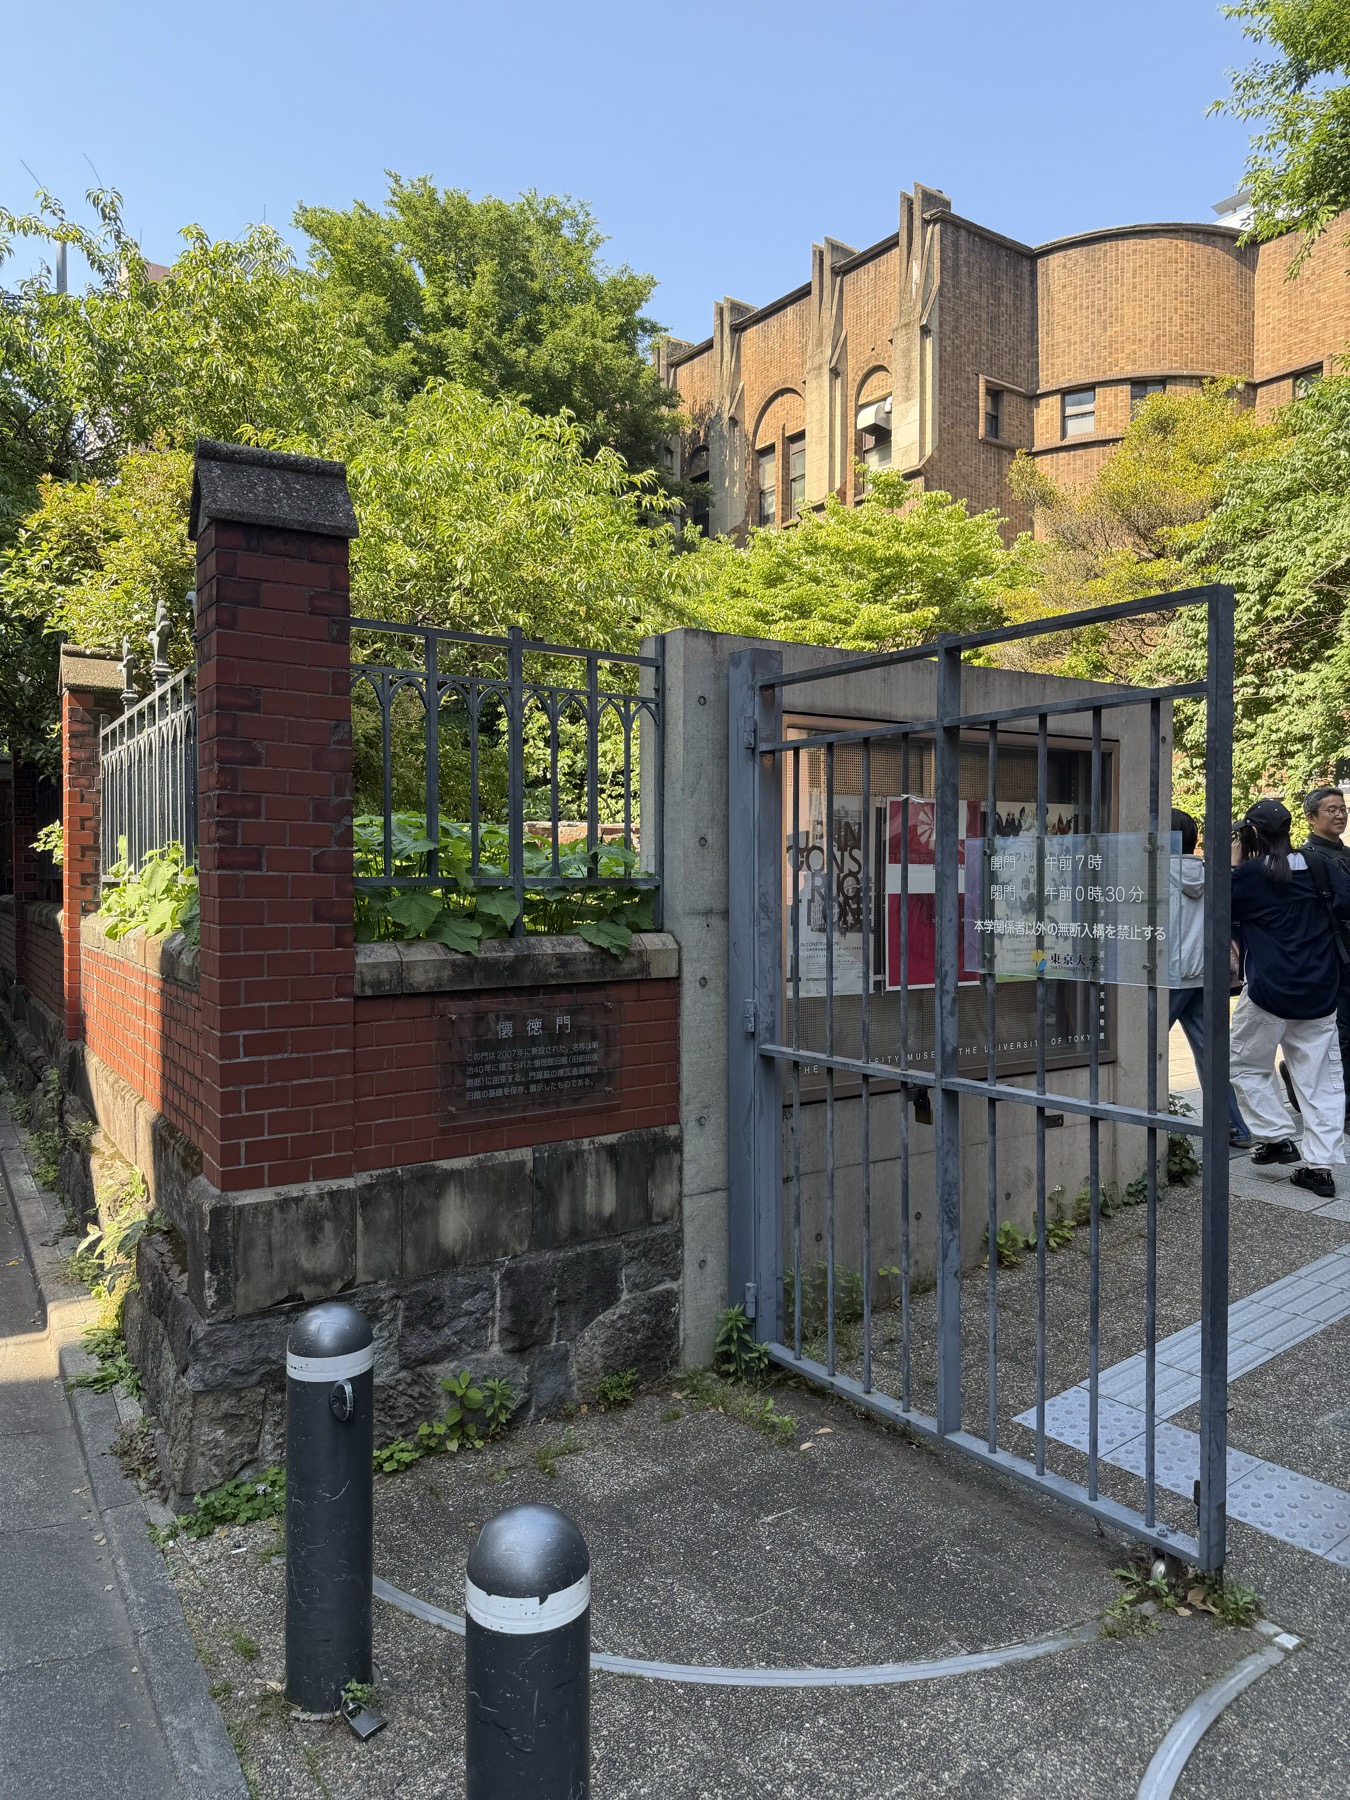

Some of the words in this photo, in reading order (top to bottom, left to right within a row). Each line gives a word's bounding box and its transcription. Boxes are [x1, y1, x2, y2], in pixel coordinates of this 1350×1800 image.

[991, 855, 1016, 871] 開門
[1045, 854, 1103, 871] 午前7時
[991, 885, 1016, 900] 閉門
[1045, 885, 1145, 902] 午前0時30分
[974, 920, 1167, 941] 本学関係者以外の無断入構を禁止する
[1050, 953, 1100, 967] 東京大学
[496, 1015, 572, 1040] 懐徳門
[959, 1046, 977, 1056] THE
[984, 1039, 1038, 1053] UIVERSIT
[1051, 1037, 1062, 1046] OF
[1068, 1034, 1091, 1043] TOKY
[907, 1050, 936, 1062] MUSE
